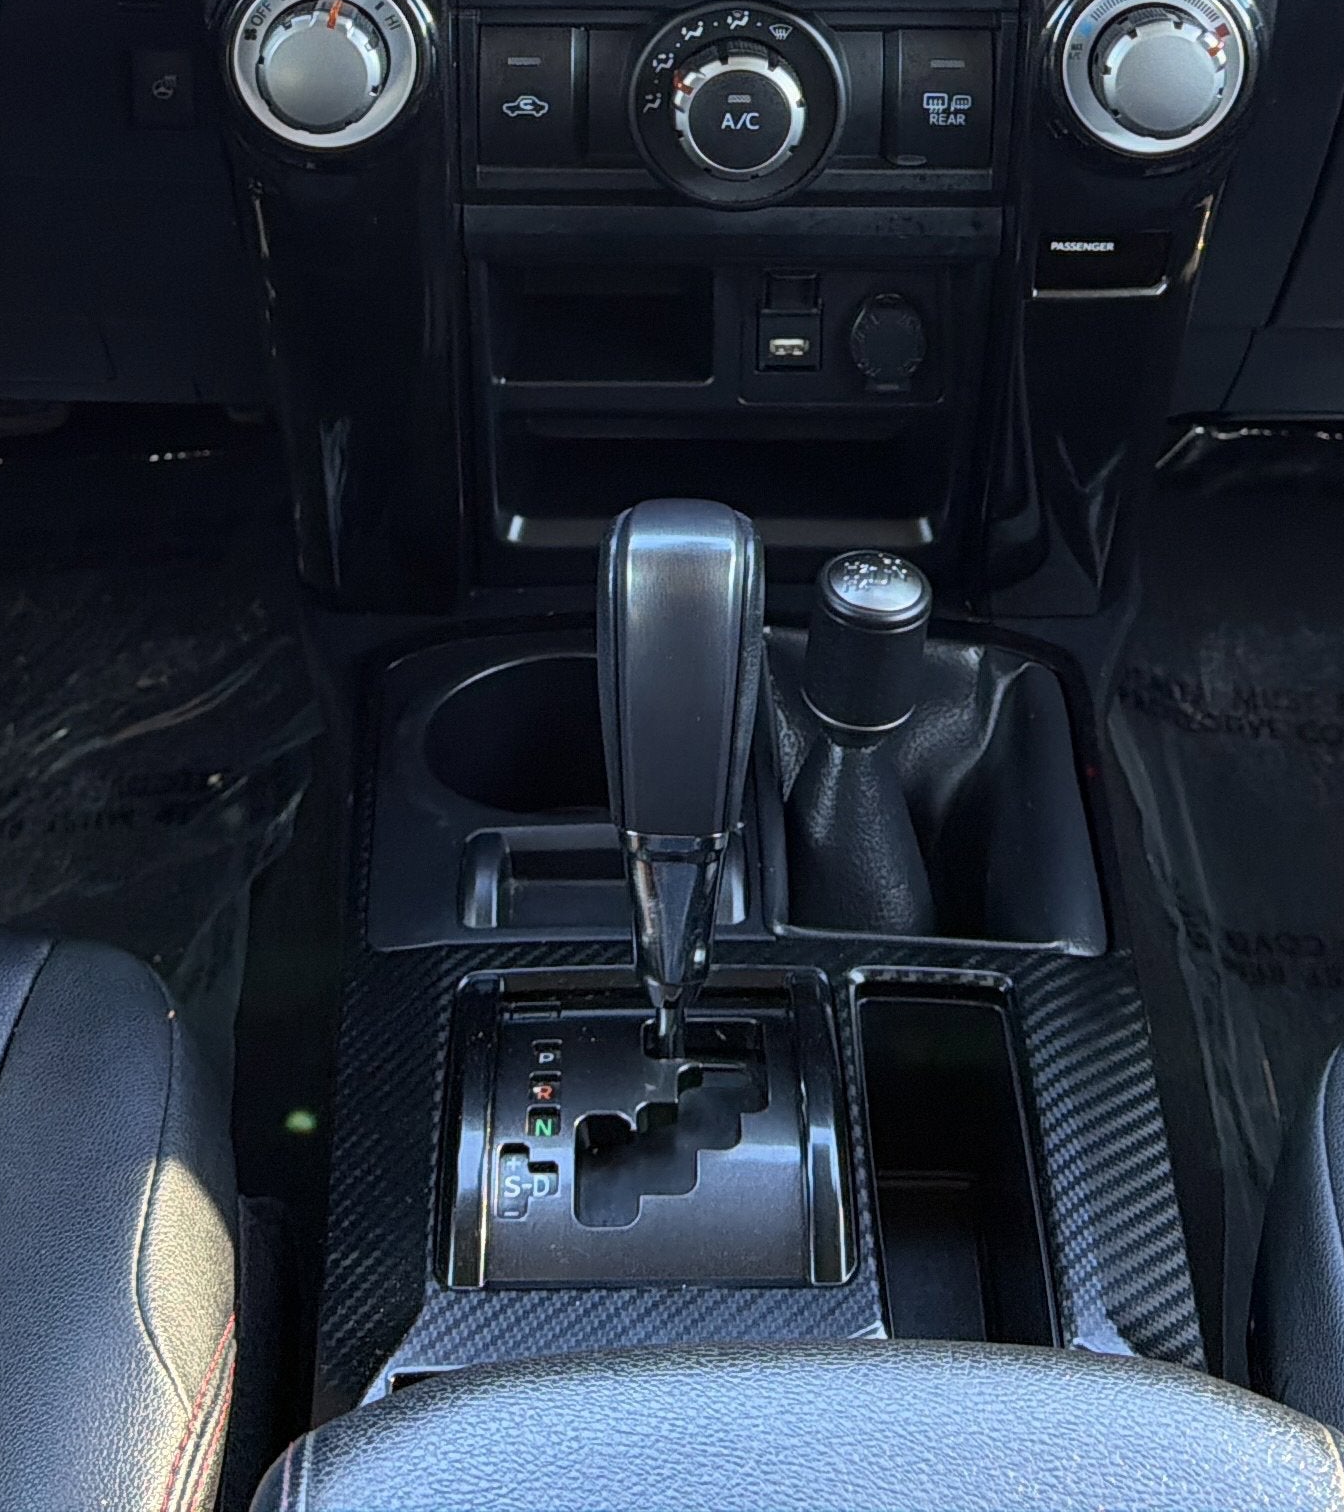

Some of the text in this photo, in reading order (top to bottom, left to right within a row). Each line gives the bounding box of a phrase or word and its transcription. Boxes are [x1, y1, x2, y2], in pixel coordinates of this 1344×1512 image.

[250, 0, 273, 27] OFF
[384, 15, 401, 31] HI
[721, 113, 760, 130] A/C
[929, 114, 965, 126] REAR
[1050, 241, 1115, 252] PASSENGER
[538, 1051, 555, 1064] P
[535, 1085, 553, 1101] R
[535, 1119, 553, 1135] N
